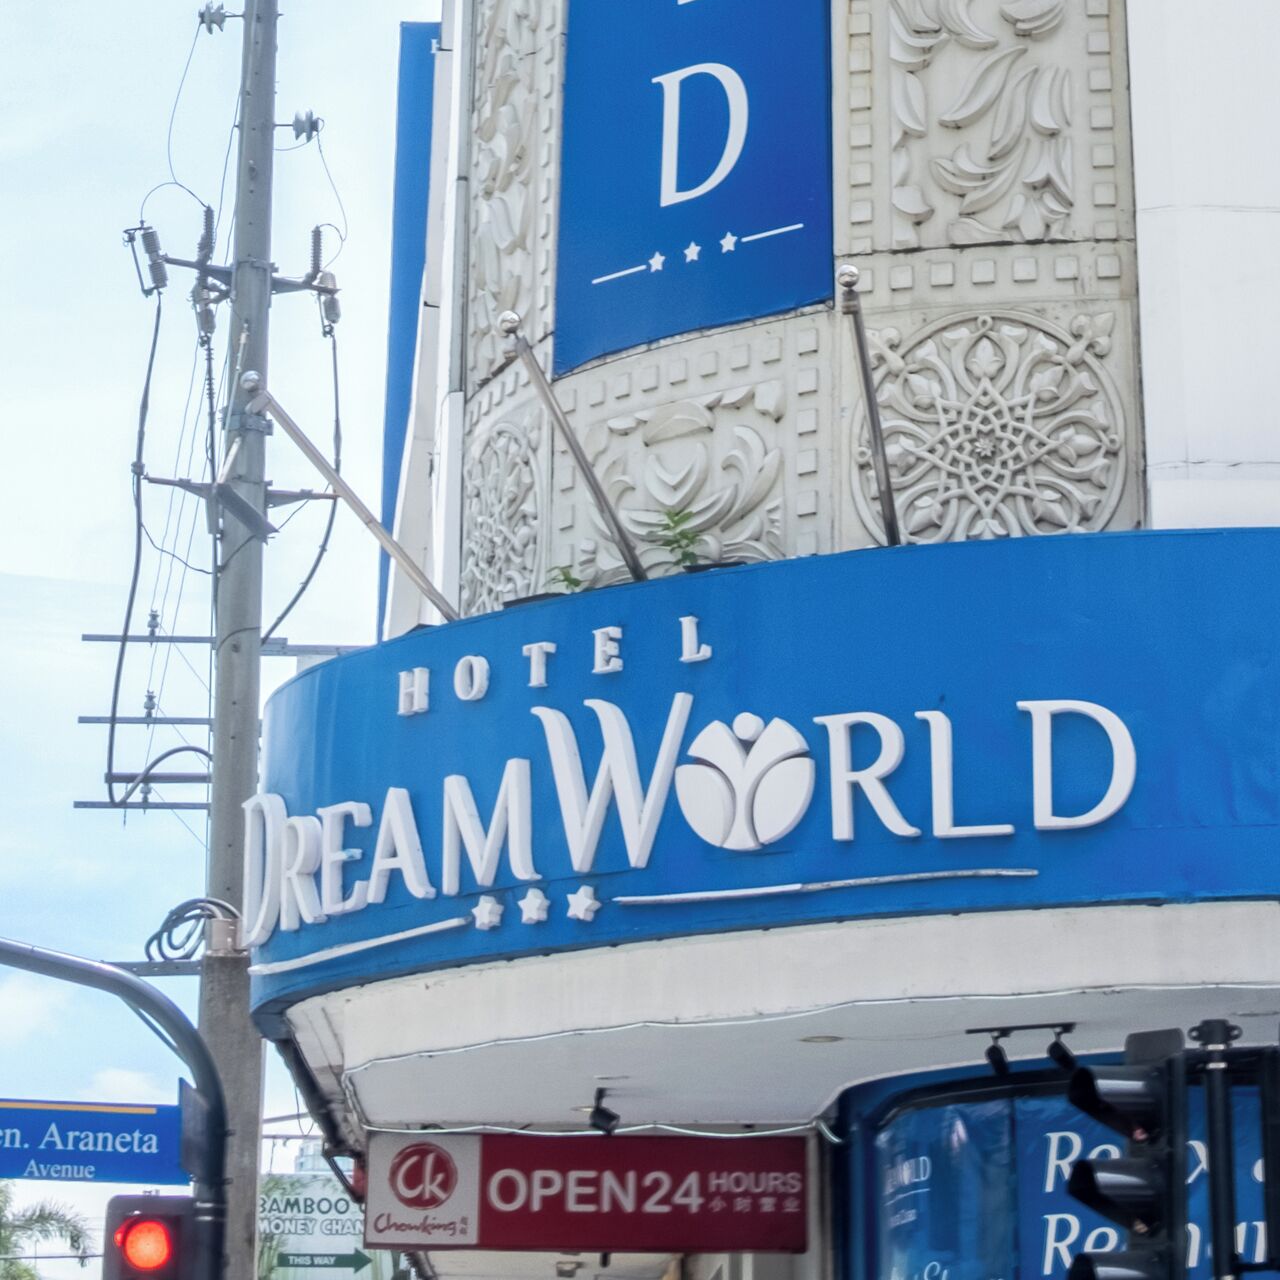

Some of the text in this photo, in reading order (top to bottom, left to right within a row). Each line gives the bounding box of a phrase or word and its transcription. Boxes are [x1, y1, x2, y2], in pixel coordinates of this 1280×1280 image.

[397, 615, 712, 716] HOTEL
[38, 1122, 159, 1154] Araneta
[23, 1159, 95, 1179] Avenue
[487, 1168, 803, 1214] OPEN 24 HOURS
[259, 1197, 350, 1215] BAMBOO
[259, 1218, 317, 1236] MONEY
[373, 1213, 457, 1236] Chowking
[287, 1255, 336, 1265] THIS WAY
